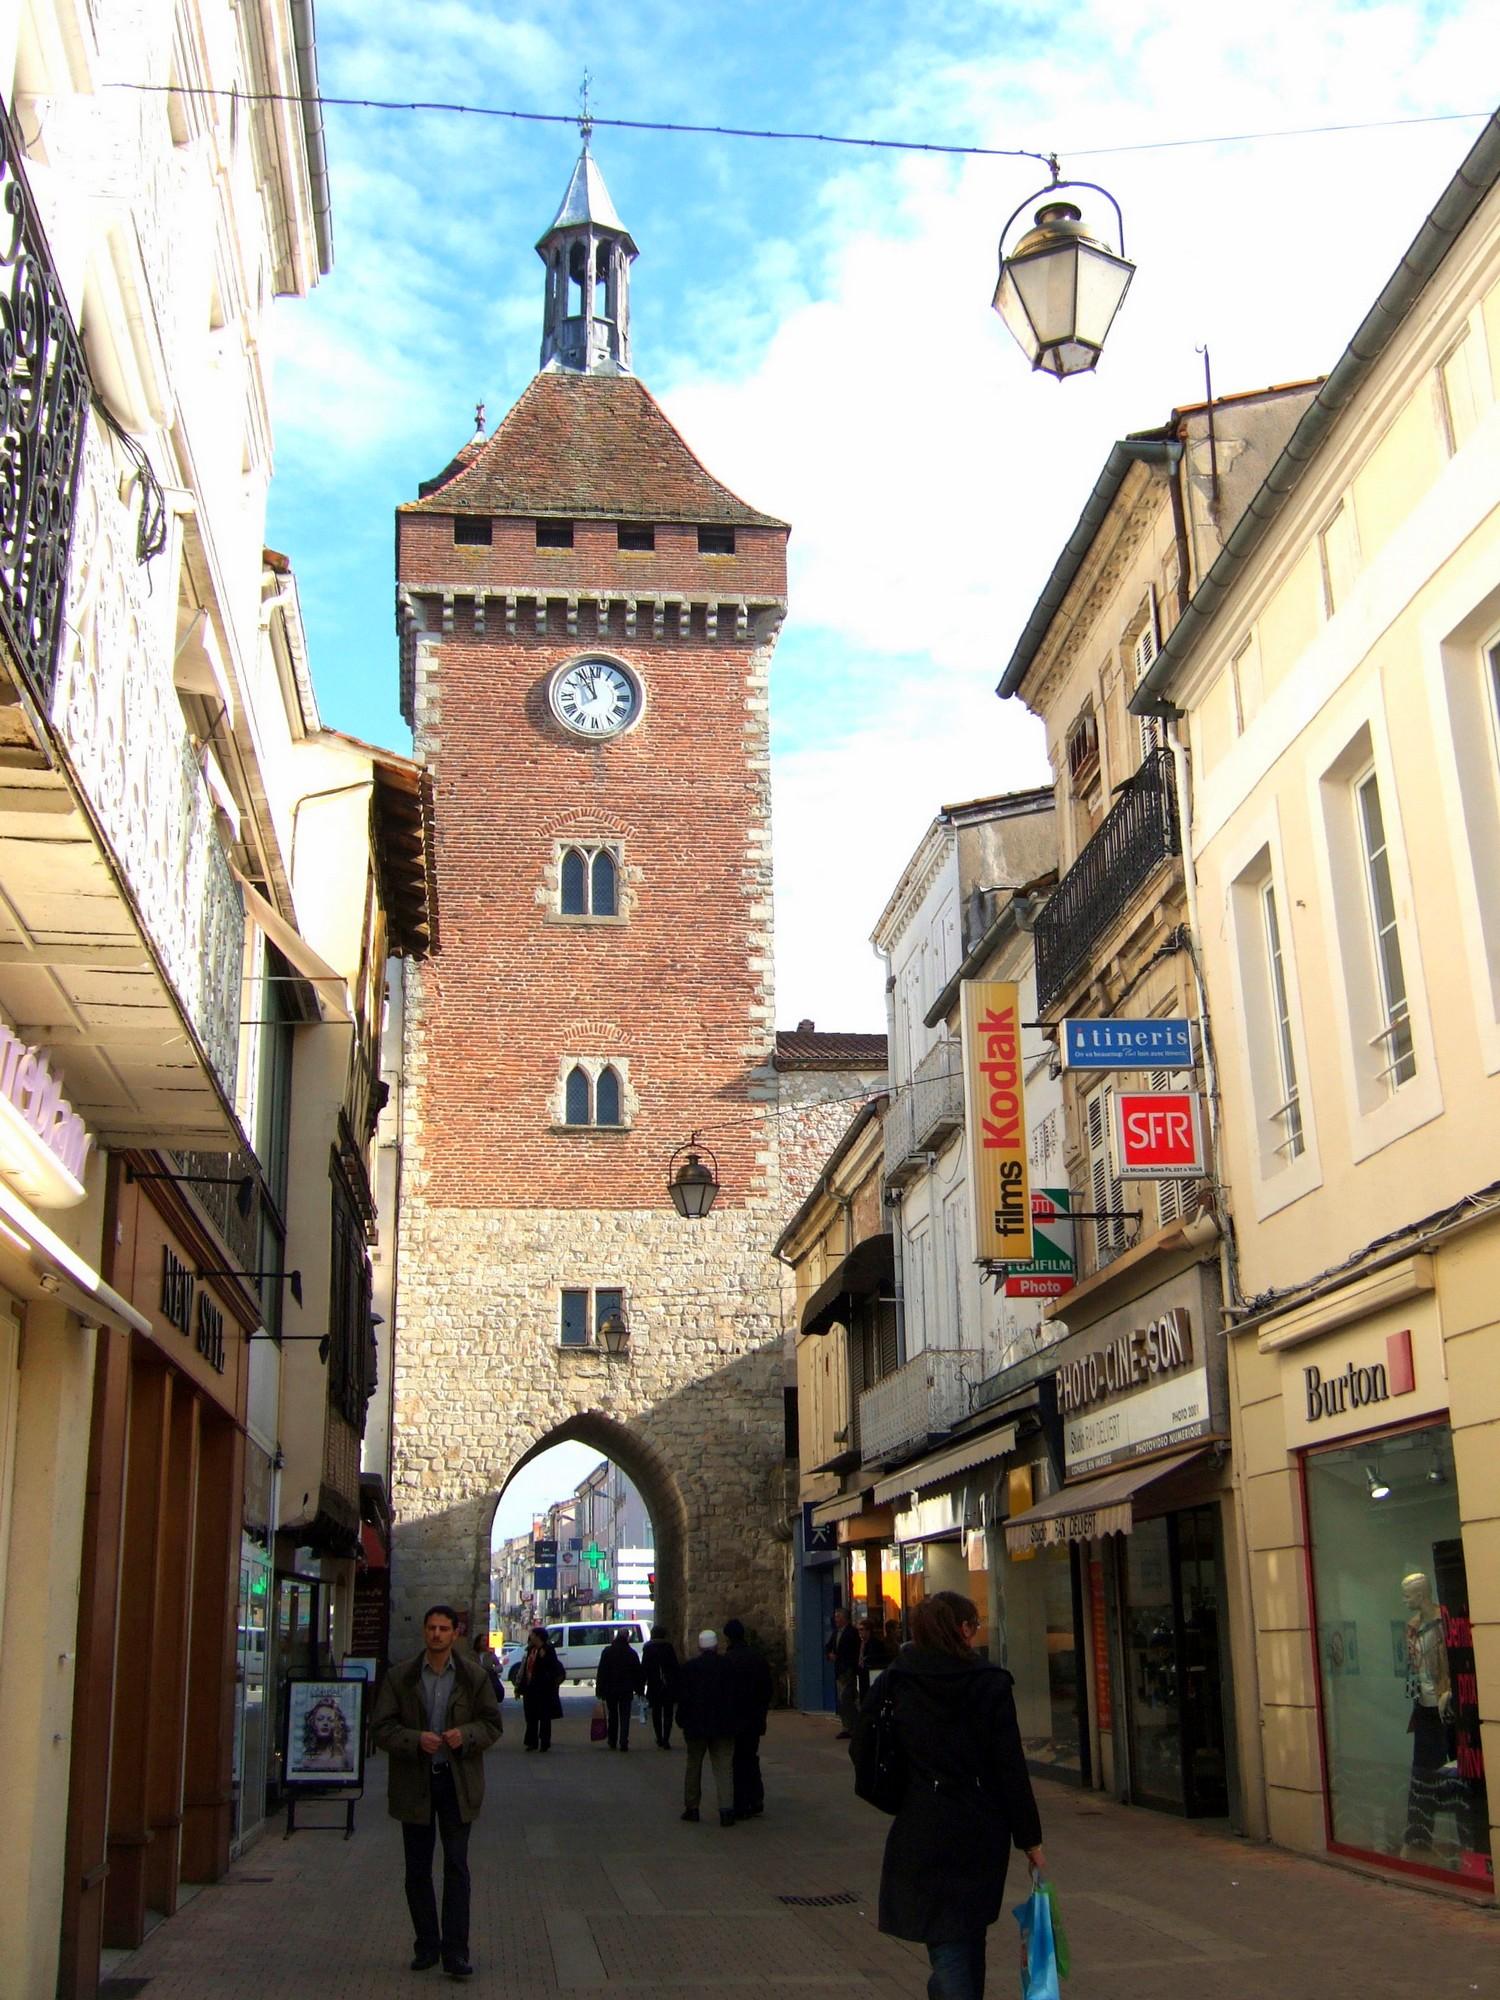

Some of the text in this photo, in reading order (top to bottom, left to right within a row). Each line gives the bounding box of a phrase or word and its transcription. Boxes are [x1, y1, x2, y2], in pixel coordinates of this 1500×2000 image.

[1076, 1028, 1188, 1047] itineris
[978, 1007, 1025, 1237] films Kodak
[1127, 1112, 1190, 1150] SFR
[1020, 1280, 1061, 1294] Photo
[1304, 1362, 1389, 1422] Burton
[1172, 1408, 1188, 1424] PHOTO
